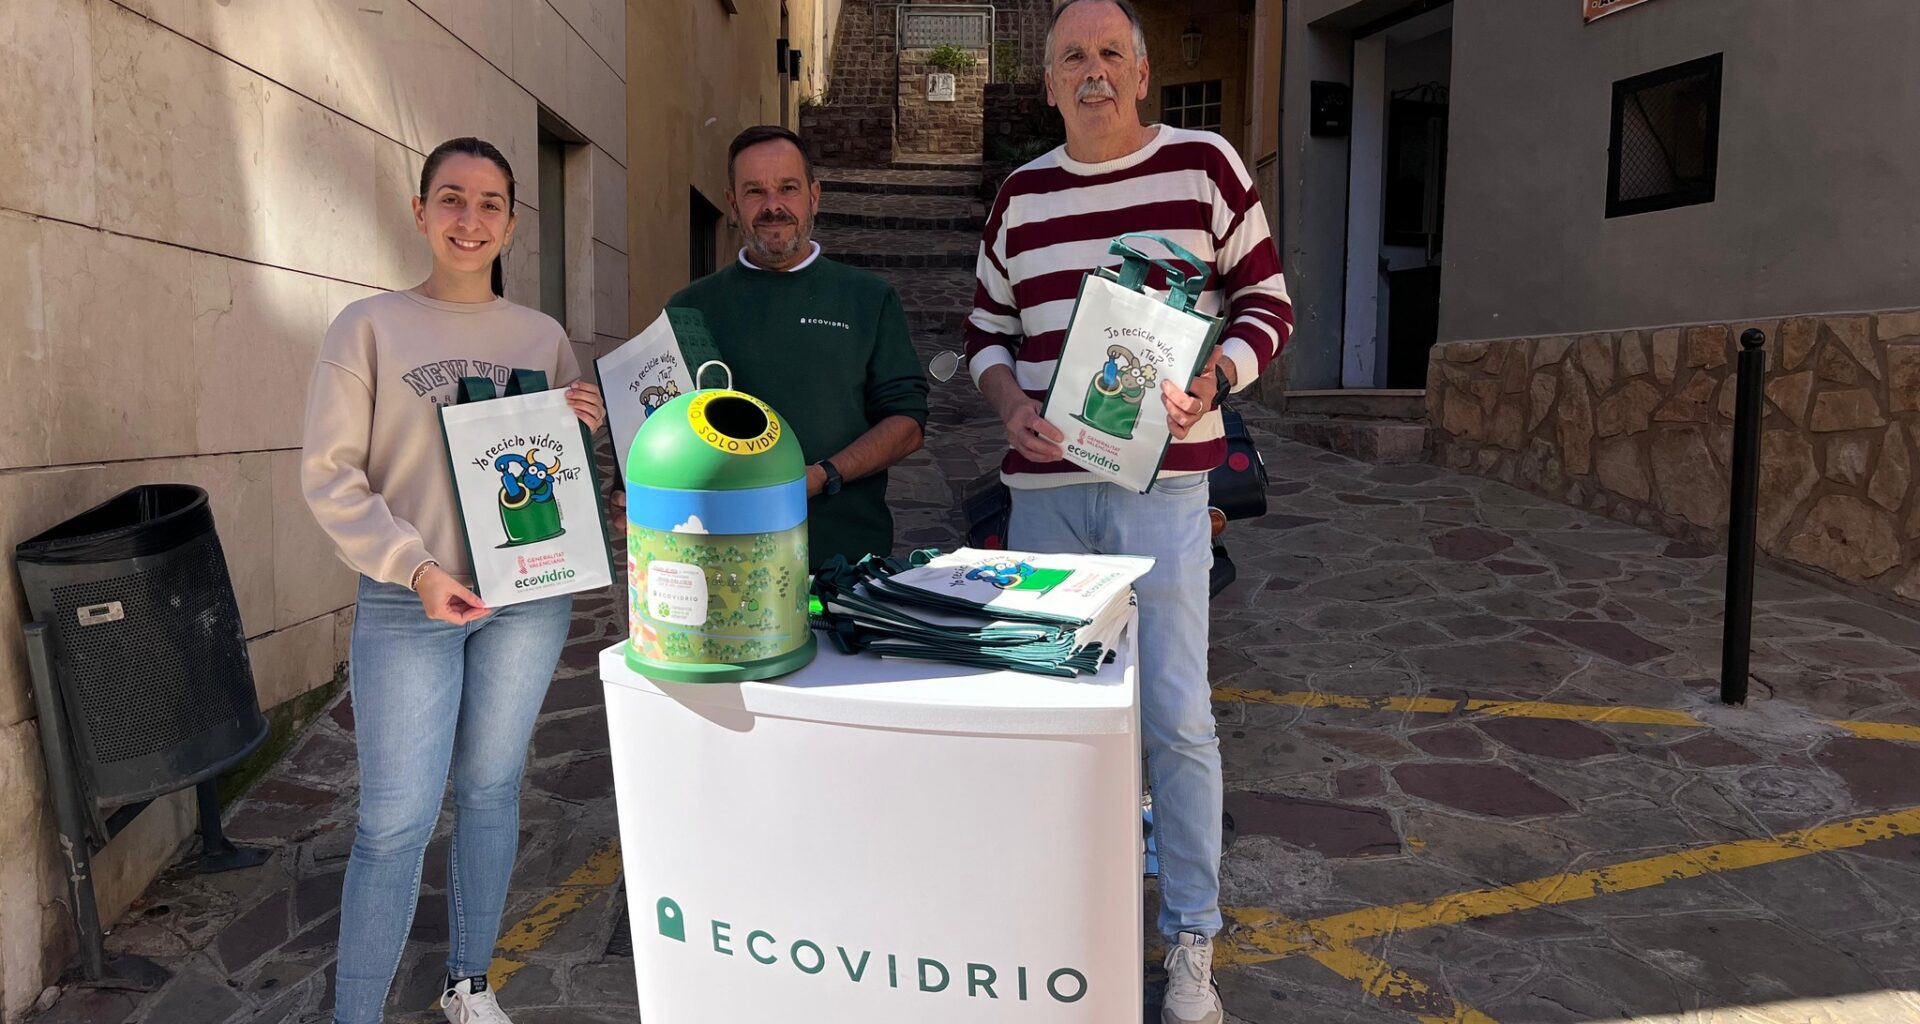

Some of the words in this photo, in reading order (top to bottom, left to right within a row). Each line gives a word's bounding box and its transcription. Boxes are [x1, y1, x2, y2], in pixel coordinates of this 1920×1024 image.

[808, 318, 849, 330] ECOVIDRIO
[1104, 326, 1119, 339] Jo
[1122, 327, 1155, 343] recicle
[1157, 340, 1175, 367] vidre,
[402, 359, 468, 397] NEW
[472, 360, 510, 387] YO
[629, 381, 640, 392] Jo
[638, 357, 659, 380] recicle
[472, 457, 489, 471] Yo
[485, 435, 525, 459] reciclo
[529, 433, 564, 457] vidrio,
[699, 426, 739, 451] SOLO
[746, 421, 779, 452] VIDRIO
[1067, 444, 1120, 472] ecovidrio
[514, 567, 575, 588] ecovidrio
[711, 919, 1088, 1003] ECOVIDRIO
